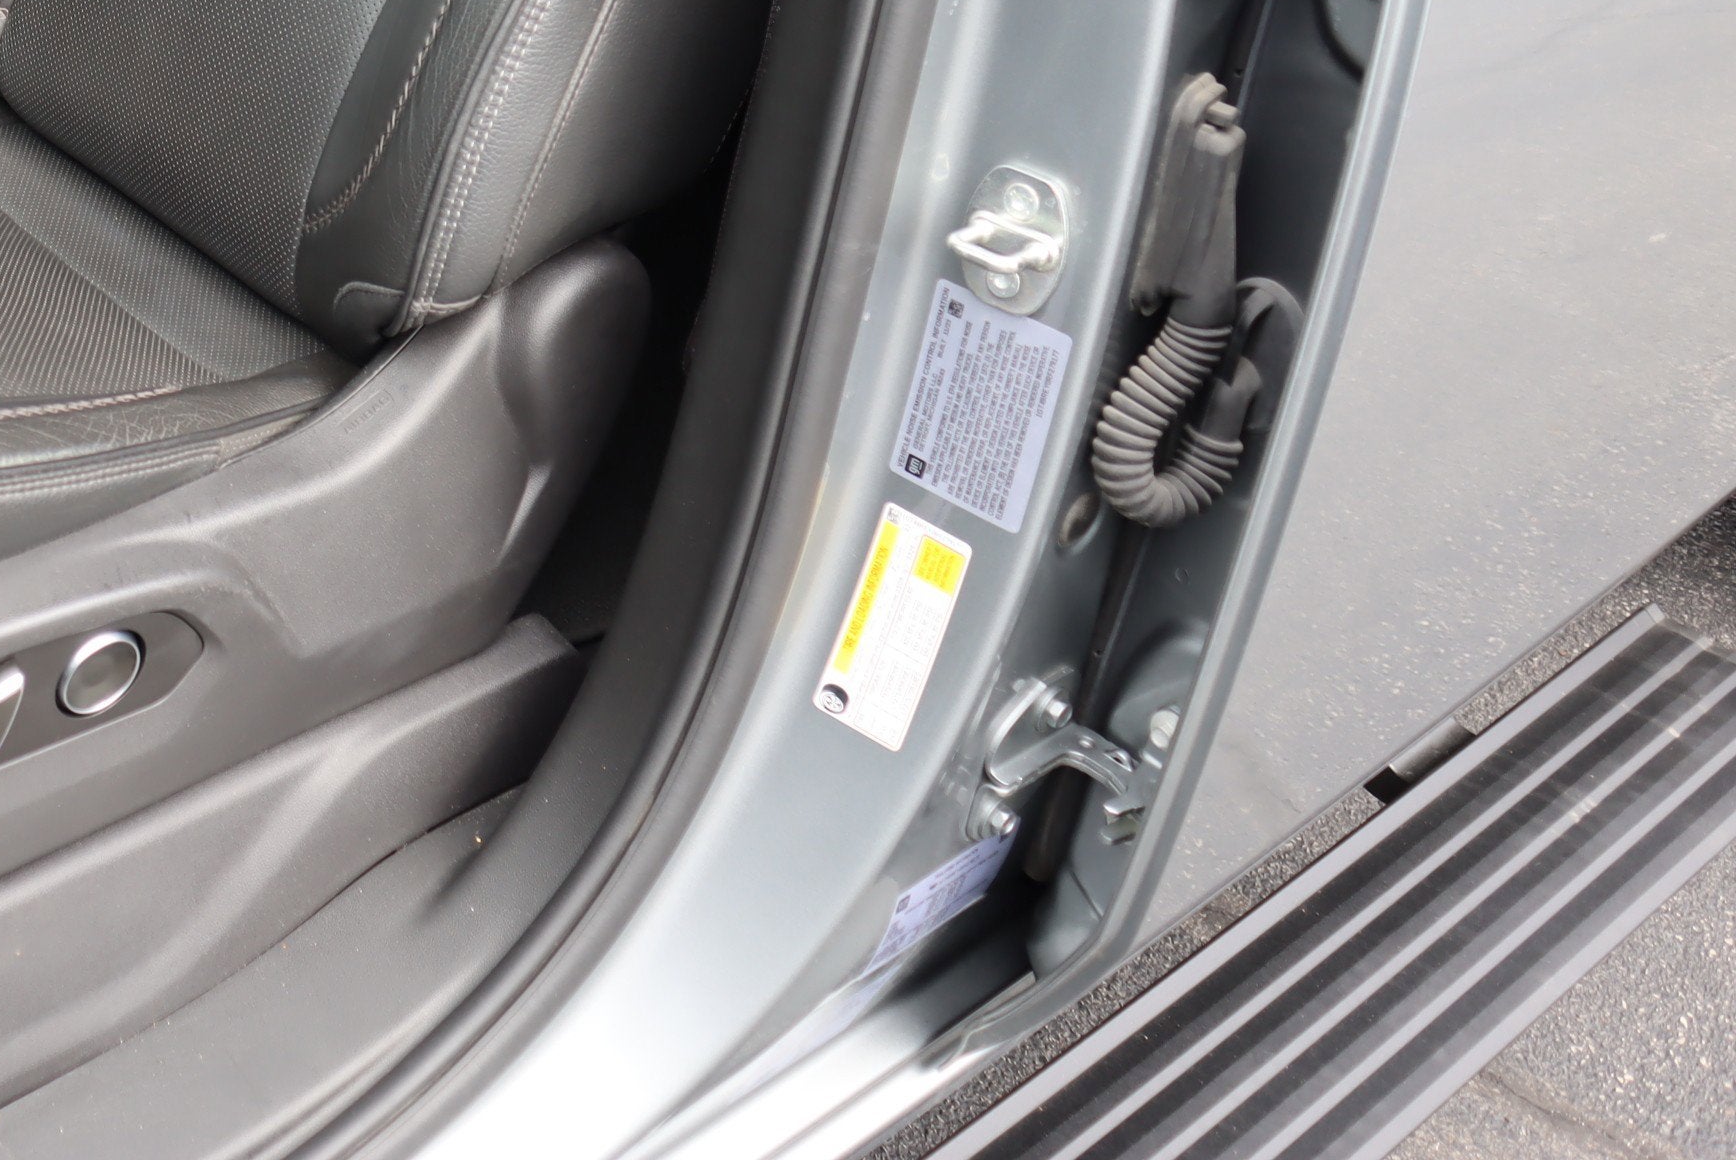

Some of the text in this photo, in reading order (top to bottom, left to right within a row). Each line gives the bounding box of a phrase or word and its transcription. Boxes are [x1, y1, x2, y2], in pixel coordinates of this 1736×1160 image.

[897, 286, 950, 469] VEHICLE NOISE EMISSION CONTROL INFORMATION
